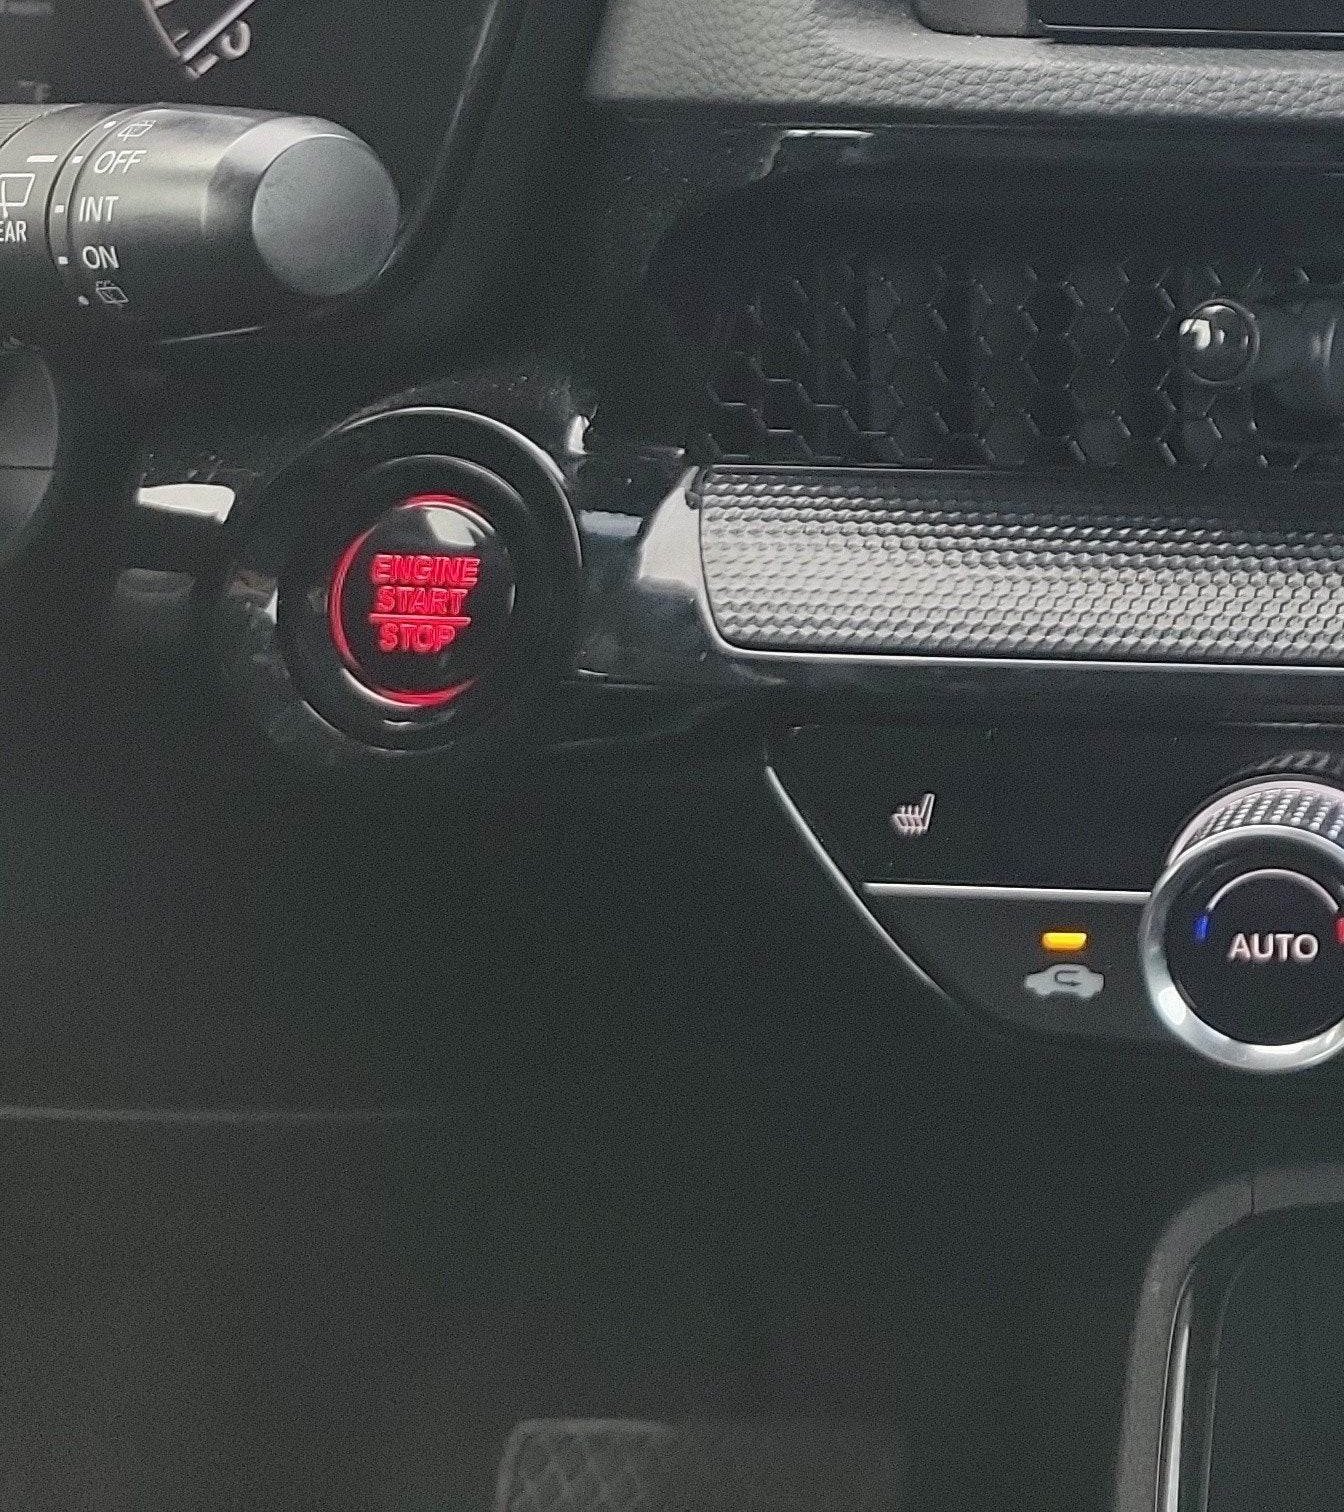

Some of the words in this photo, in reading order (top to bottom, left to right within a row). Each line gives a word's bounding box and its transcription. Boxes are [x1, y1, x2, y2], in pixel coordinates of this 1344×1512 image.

[221, 20, 251, 60] 0
[94, 150, 147, 174] OFF
[79, 196, 119, 222] INT
[82, 245, 120, 270] ON
[372, 555, 481, 586] ENGINE
[376, 586, 468, 615] START
[379, 623, 456, 652] STOP
[1228, 931, 1320, 963] AUTO
